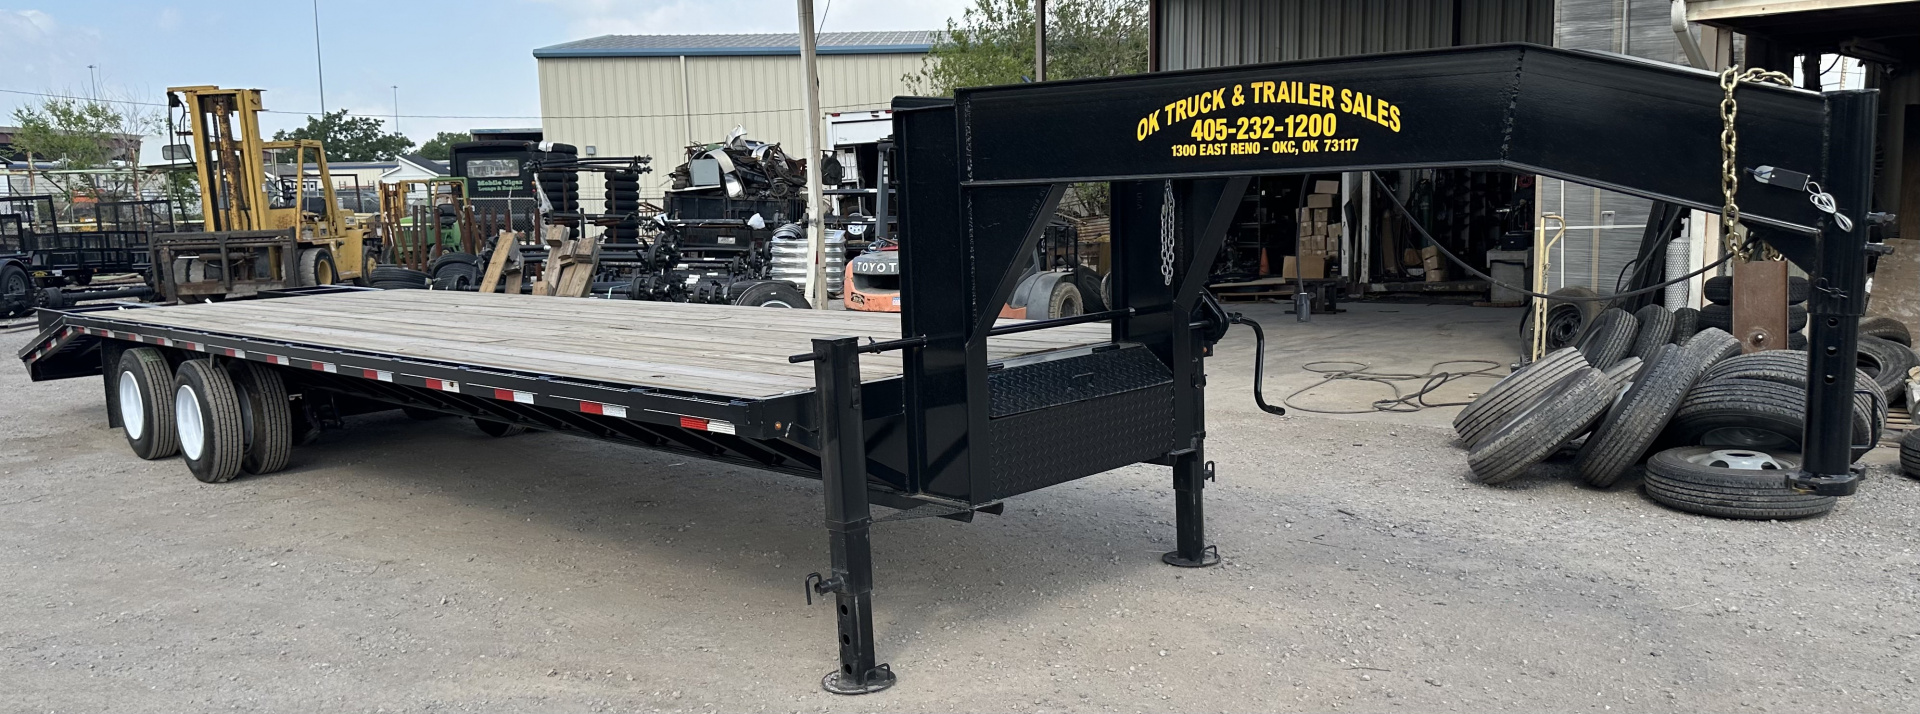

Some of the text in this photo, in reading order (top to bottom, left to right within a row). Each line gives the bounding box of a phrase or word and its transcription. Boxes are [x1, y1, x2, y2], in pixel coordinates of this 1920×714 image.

[1136, 80, 1401, 142] OK TRUCK & TRAILER SALES
[1190, 113, 1337, 142] 405-232-1200
[1171, 143, 1197, 157] 1300
[1199, 143, 1228, 156] EAST
[1230, 142, 1261, 155] RENO
[1271, 141, 1299, 156] OKC,
[1301, 139, 1319, 153] OK
[1323, 138, 1359, 152] 73117
[857, 262, 899, 273] TOYOT
